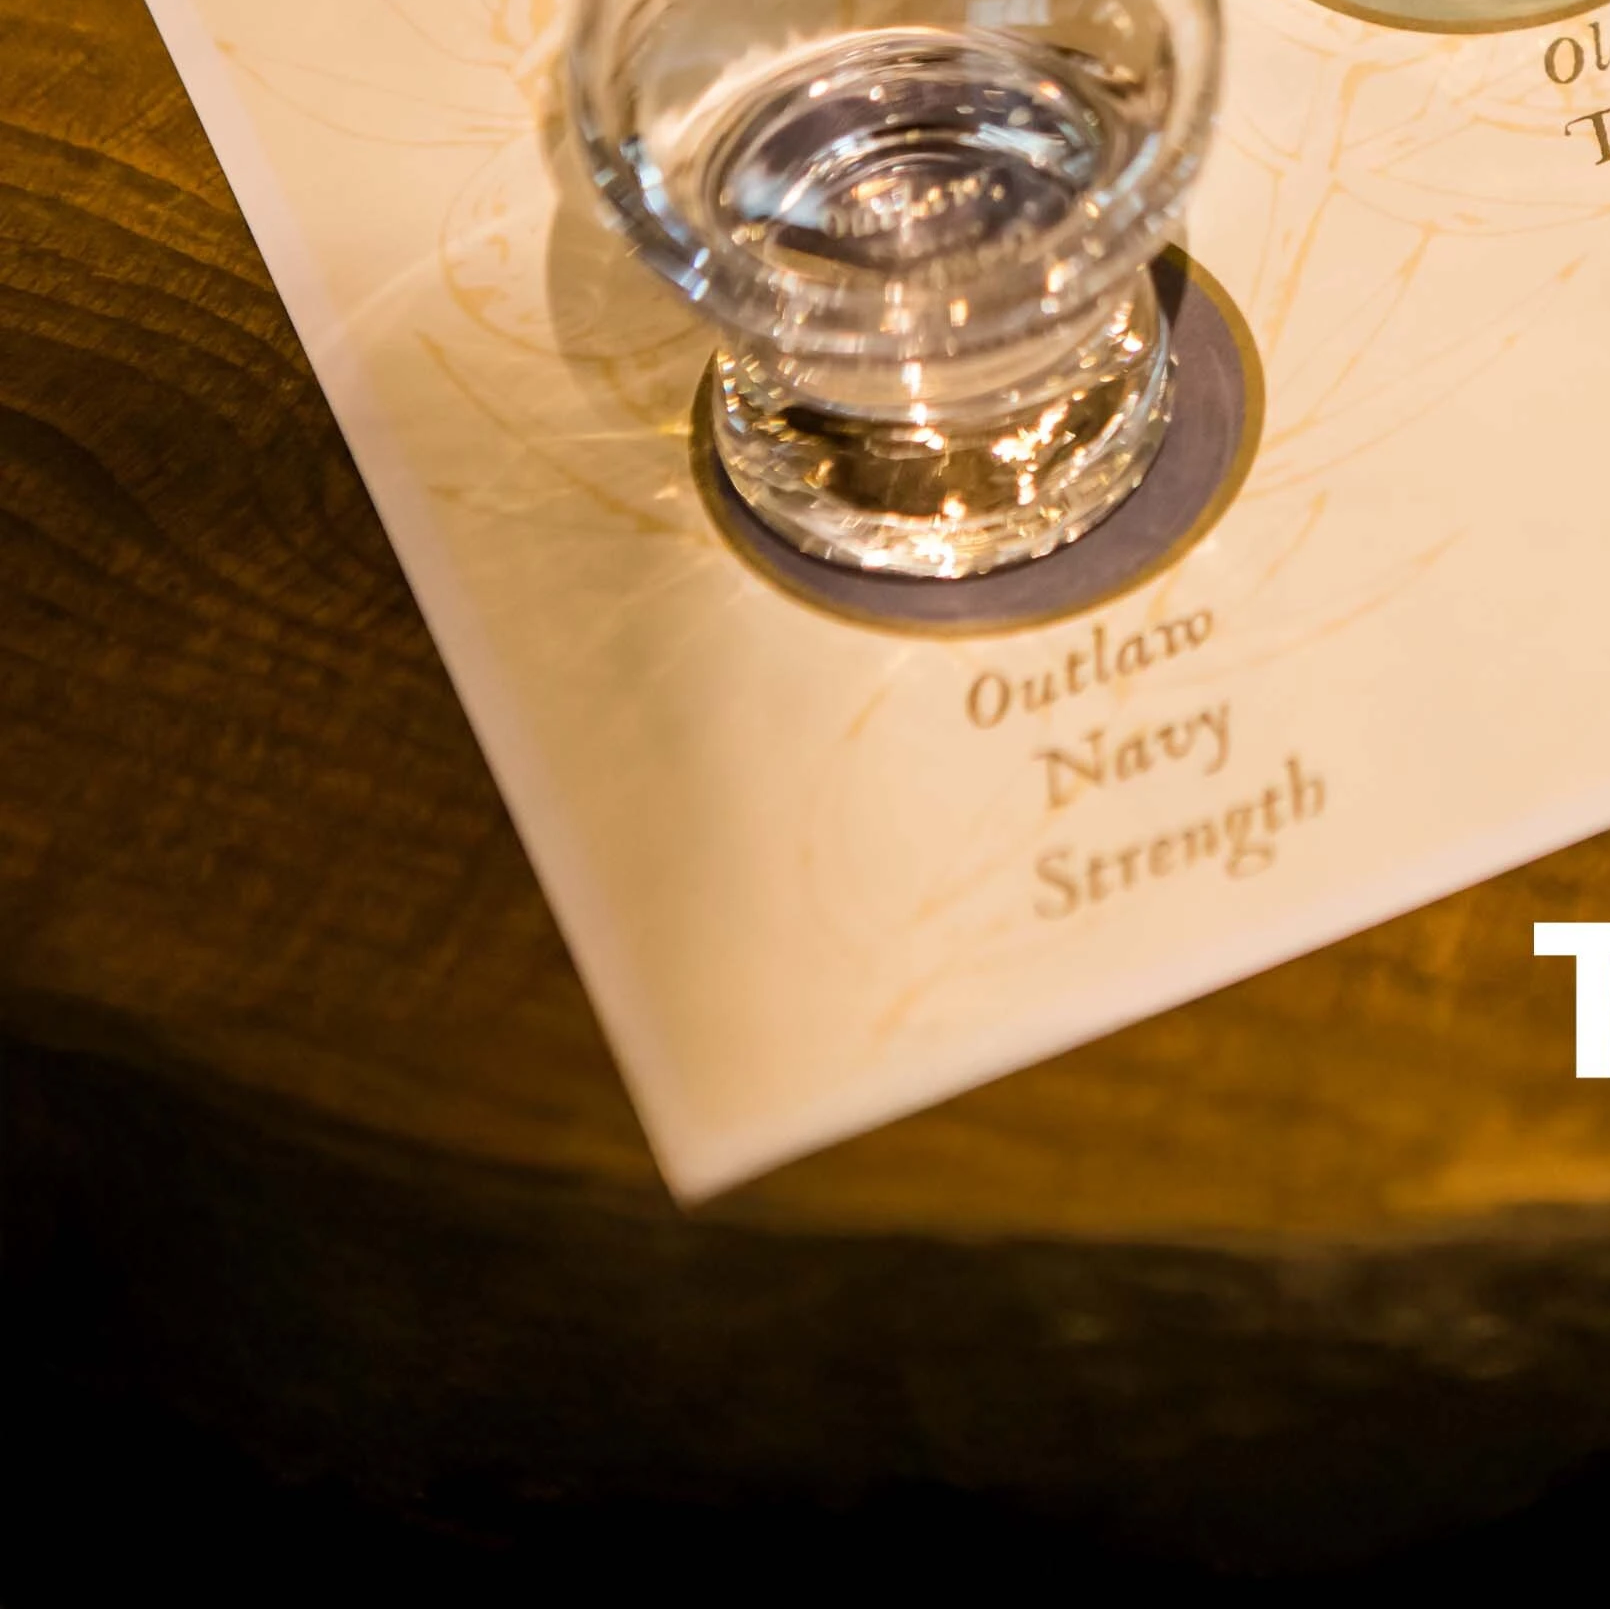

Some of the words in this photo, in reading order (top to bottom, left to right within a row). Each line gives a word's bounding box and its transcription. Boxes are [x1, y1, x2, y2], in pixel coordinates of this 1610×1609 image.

[964, 608, 1213, 730] Outlaw
[1034, 698, 1231, 812] Navy
[1033, 751, 1328, 921] Strength
